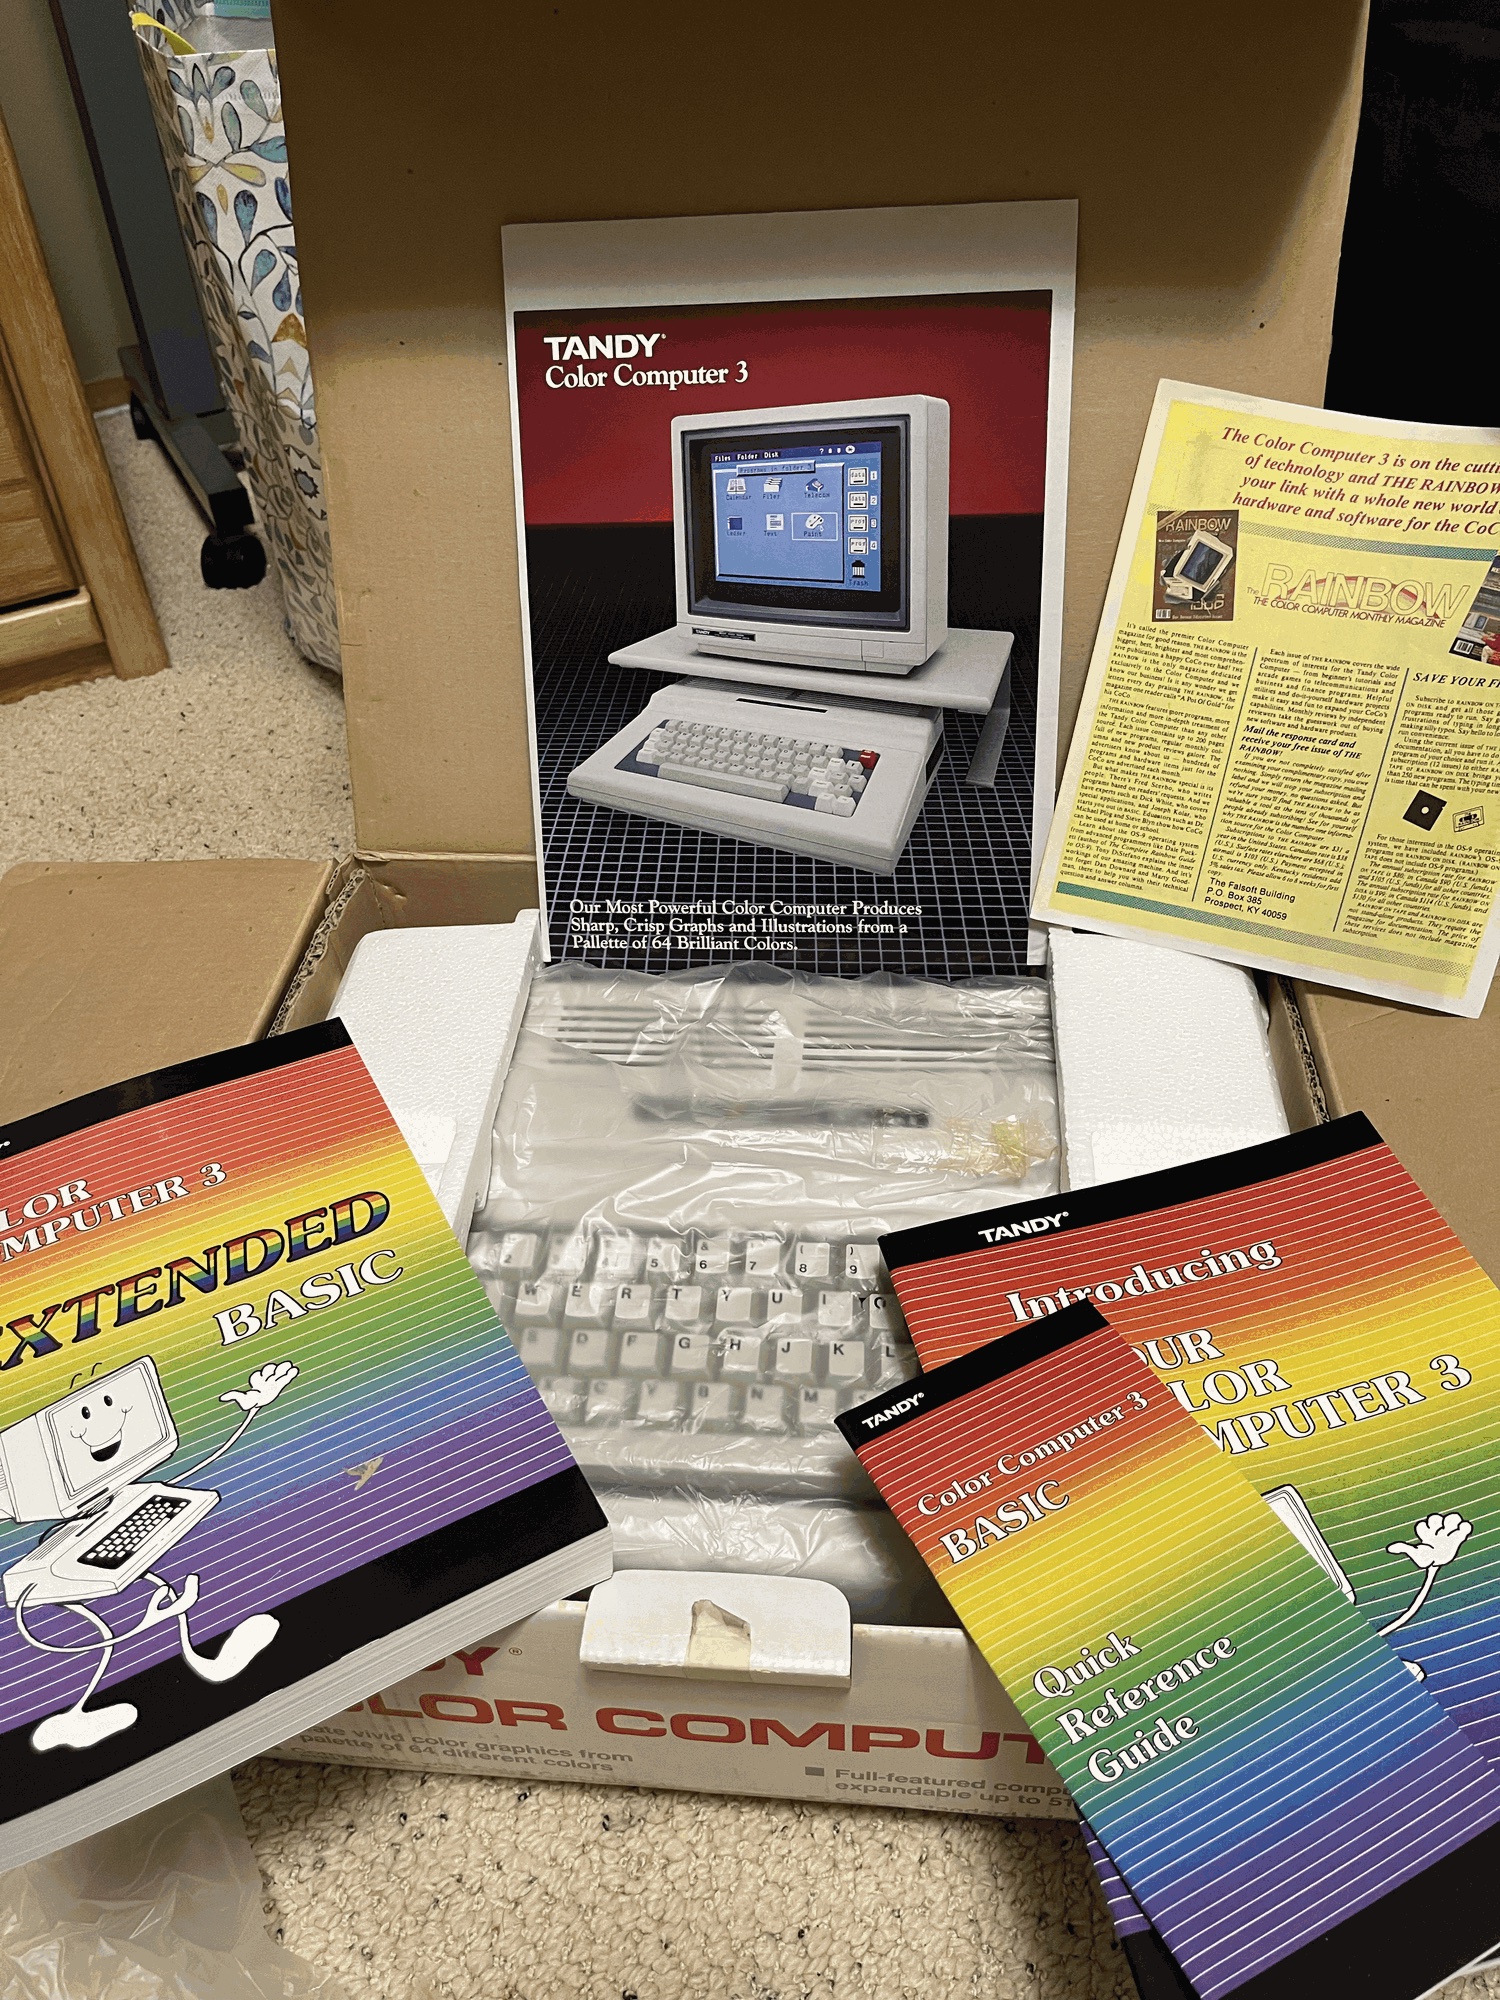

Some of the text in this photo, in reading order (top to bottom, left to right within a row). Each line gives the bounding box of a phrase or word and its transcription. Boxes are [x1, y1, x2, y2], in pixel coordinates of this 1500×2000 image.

[545, 360, 748, 391] Color Computer 3
[737, 453, 758, 461] Folder
[764, 451, 779, 459] Disk
[1221, 427, 1250, 445] The
[1254, 433, 1296, 452] Color
[1300, 441, 1376, 466] Computer
[1378, 453, 1390, 466] 3
[1393, 453, 1407, 468] is
[1409, 459, 1431, 470] on
[1435, 457, 1461, 472] the
[1245, 454, 1263, 469] of
[1264, 456, 1344, 483] technology
[1348, 472, 1380, 486] and
[1382, 475, 1418, 490] THE
[1240, 475, 1498, 514] your link with a whole new world
[1232, 492, 1500, 535] hardware and software for the CoC
[1246, 586, 1260, 596] The
[1261, 563, 1471, 620] RAINBOW
[1253, 597, 1449, 628] THE COLOR COMPUTER MONTHLY MAGAZINE
[1269, 648, 1285, 656] Each
[1286, 651, 1301, 659] issue
[1352, 660, 1373, 668] covers
[1413, 672, 1486, 687] SAVE YOUR
[1239, 743, 1283, 757] RAINBOW!
[1241, 735, 1362, 760] receive your free issue of THE
[1243, 725, 1357, 749] Mail the response card and
[1209, 877, 1296, 903] The Falsoft Building
[1227, 891, 1244, 902] Box
[1246, 895, 1262, 905] 385
[569, 899, 923, 918] Our Most Powerful Color Computer Produces
[1204, 896, 1288, 920] Prospect, KY 40059
[571, 918, 908, 936] Sharp, Crisp Graphs and Illustrations from a
[572, 935, 799, 951] Pallette of 64 Brilliant Colors.
[199, 1162, 228, 1188] 3
[0, 1190, 391, 1371] XTENDED
[699, 1259, 858, 1274] 6 8 9
[1005, 1240, 1283, 1322] Introducing
[212, 1249, 404, 1347] BASIC
[621, 1287, 783, 1304] R T U
[678, 1337, 895, 1358] G J K L
[1131, 1329, 1225, 1370] UR
[1166, 1359, 1292, 1413] LOR
[1429, 1353, 1472, 1392] 3
[917, 1390, 1149, 1516] Color Computer 3
[939, 1480, 1070, 1564] BASIC
[1033, 1631, 1142, 1699] Quick
[1055, 1636, 1237, 1746] Reference
[347, 1692, 1046, 1764] LOR COMPUT
[300, 1735, 374, 1749] palette
[380, 1743, 402, 1751] of
[409, 1744, 435, 1754] 64
[443, 1744, 537, 1765] different
[543, 1756, 613, 1772] colors
[352, 1730, 405, 1742] vivid
[412, 1734, 468, 1749] color
[475, 1741, 573, 1759] graphics
[579, 1749, 634, 1762] from
[1087, 1715, 1200, 1784] Guide
[834, 1782, 972, 1799] expandable
[980, 1793, 1009, 1804] up
[1018, 1795, 1041, 1805] to
[835, 1768, 986, 1789] Full-featured
